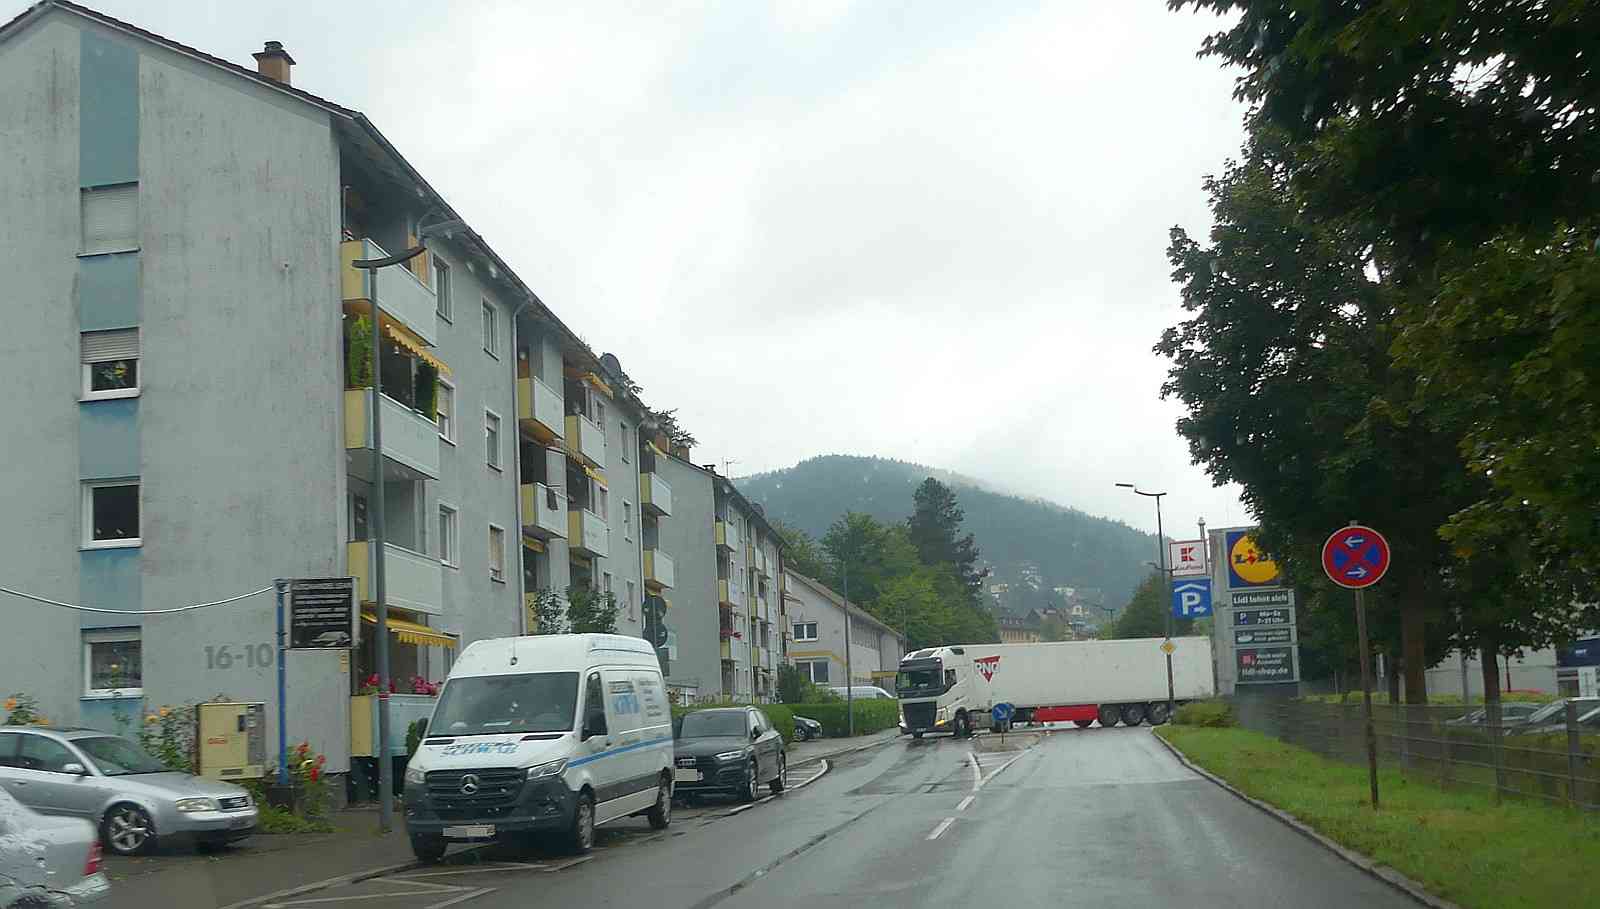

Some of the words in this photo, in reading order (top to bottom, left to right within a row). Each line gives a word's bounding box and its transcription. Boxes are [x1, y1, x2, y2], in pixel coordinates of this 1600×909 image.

[1181, 592, 1201, 615] P
[1233, 594, 1248, 604] Lidl
[1271, 592, 1288, 602] sich
[204, 642, 274, 670] 16-10
